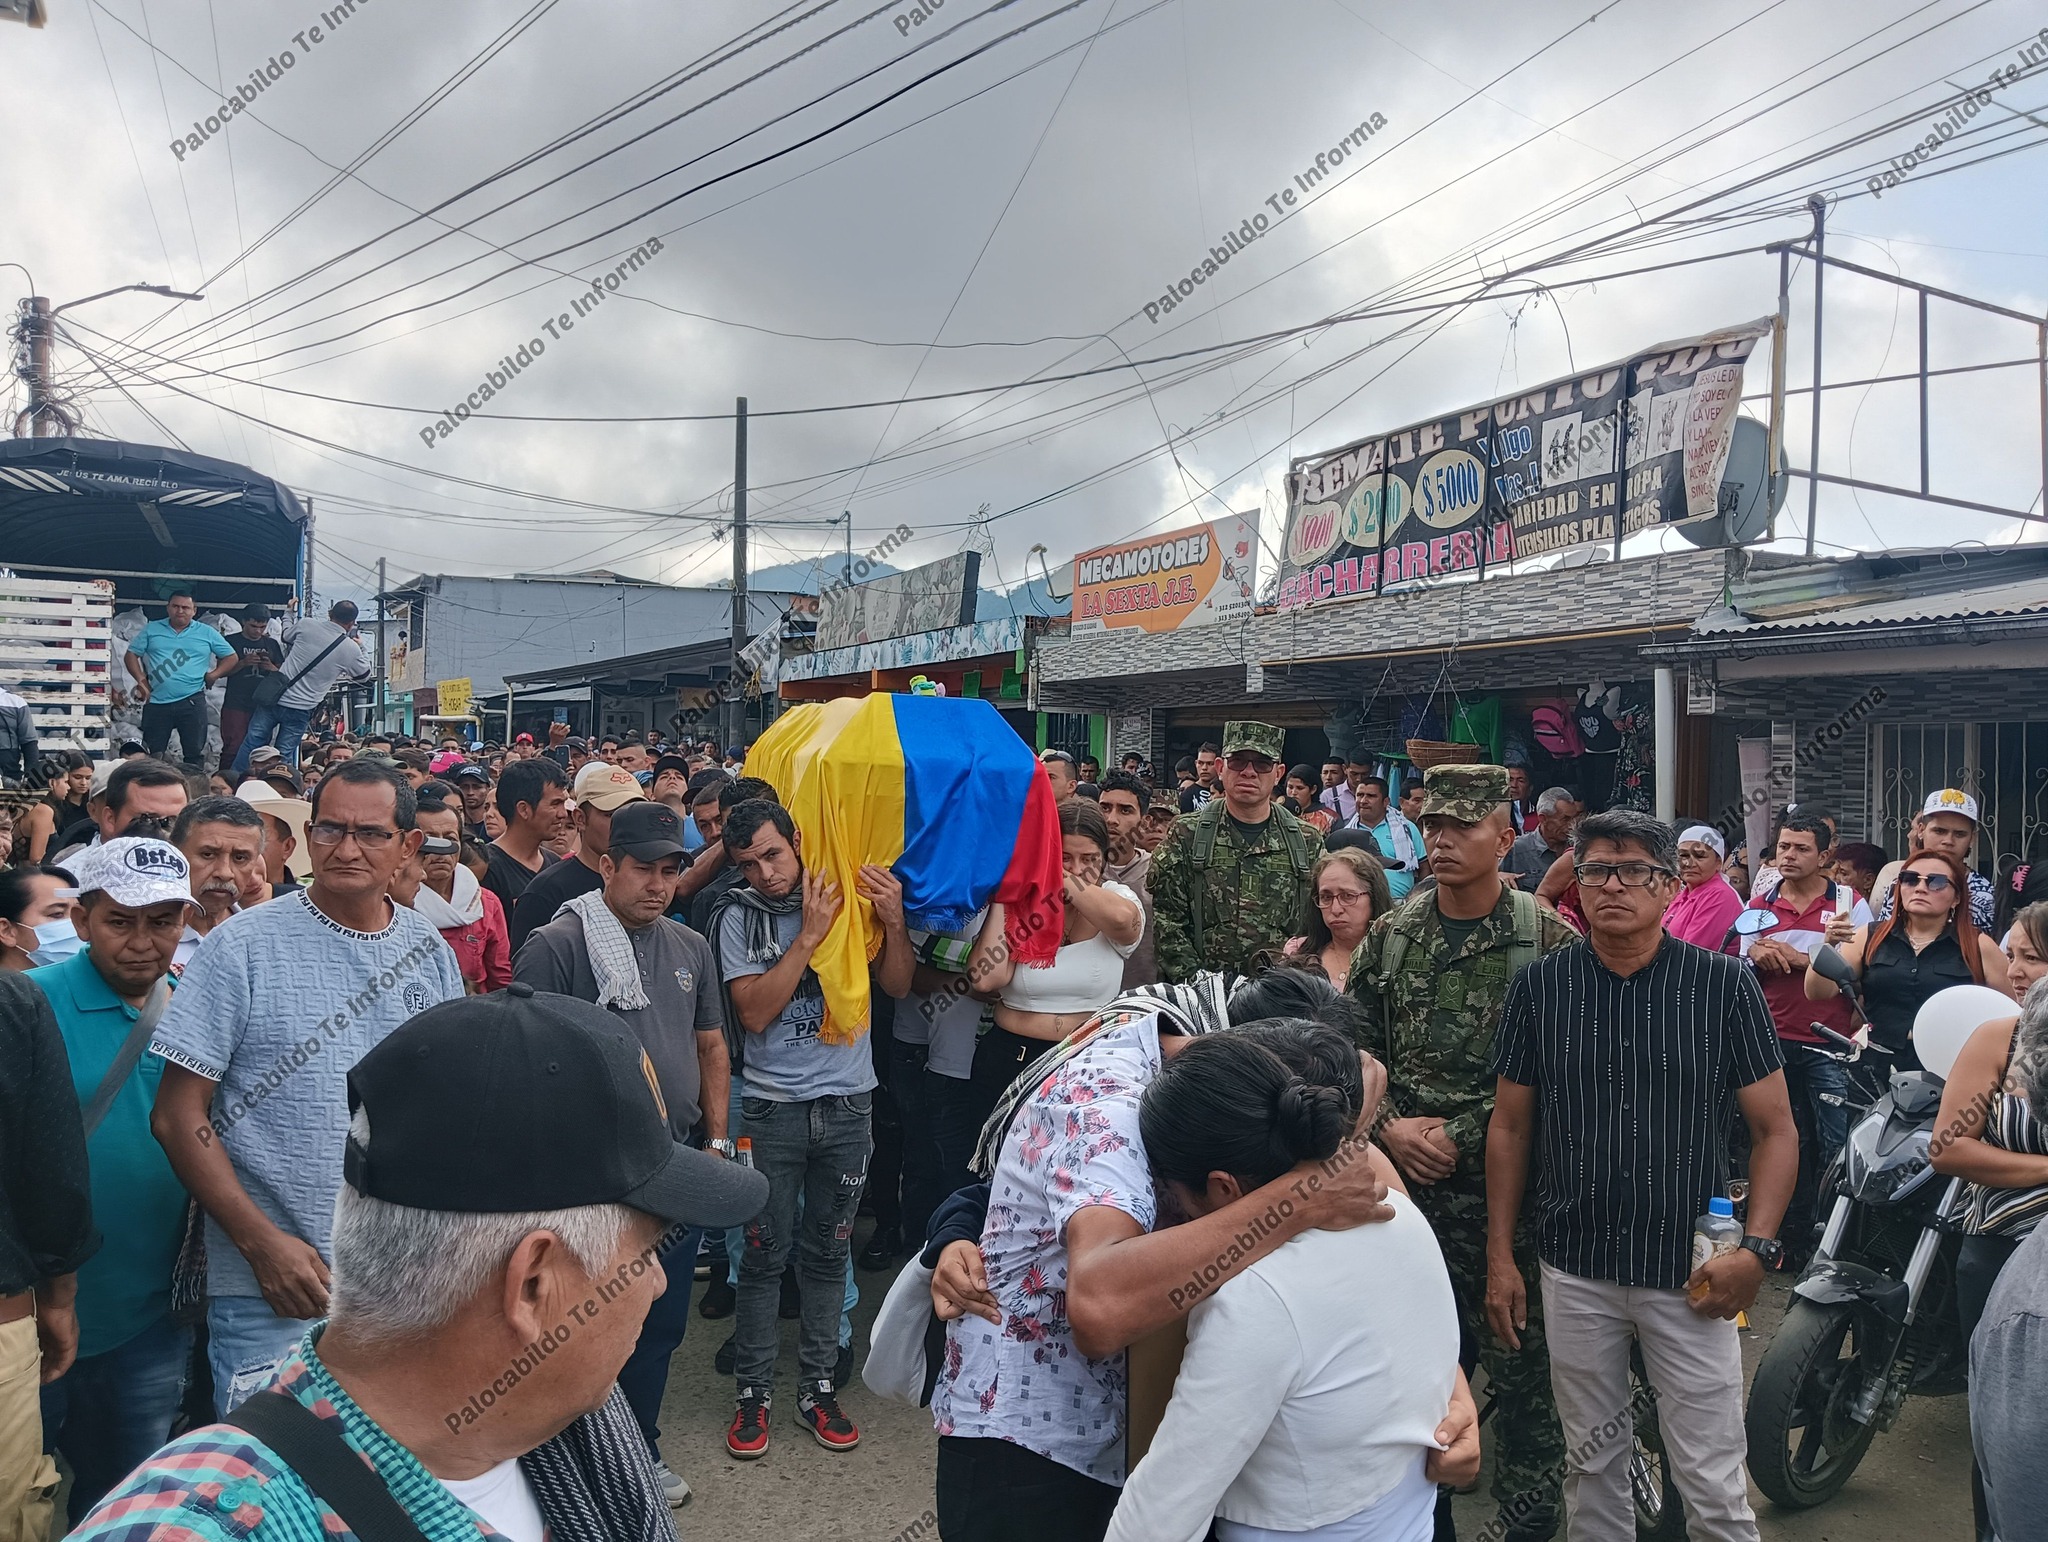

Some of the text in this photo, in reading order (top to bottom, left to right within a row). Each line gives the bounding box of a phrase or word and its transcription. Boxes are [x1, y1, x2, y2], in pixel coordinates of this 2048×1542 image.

[56, 469, 89, 479] JEÚS
[91, 473, 104, 481] TE
[107, 475, 131, 485] AMA
[1590, 483, 1616, 508] EN
[1078, 531, 1210, 586] MECAMOTORES
[1081, 592, 1103, 618] LA
[1104, 582, 1161, 615] SEXTA
[785, 1041, 800, 1049] THE
